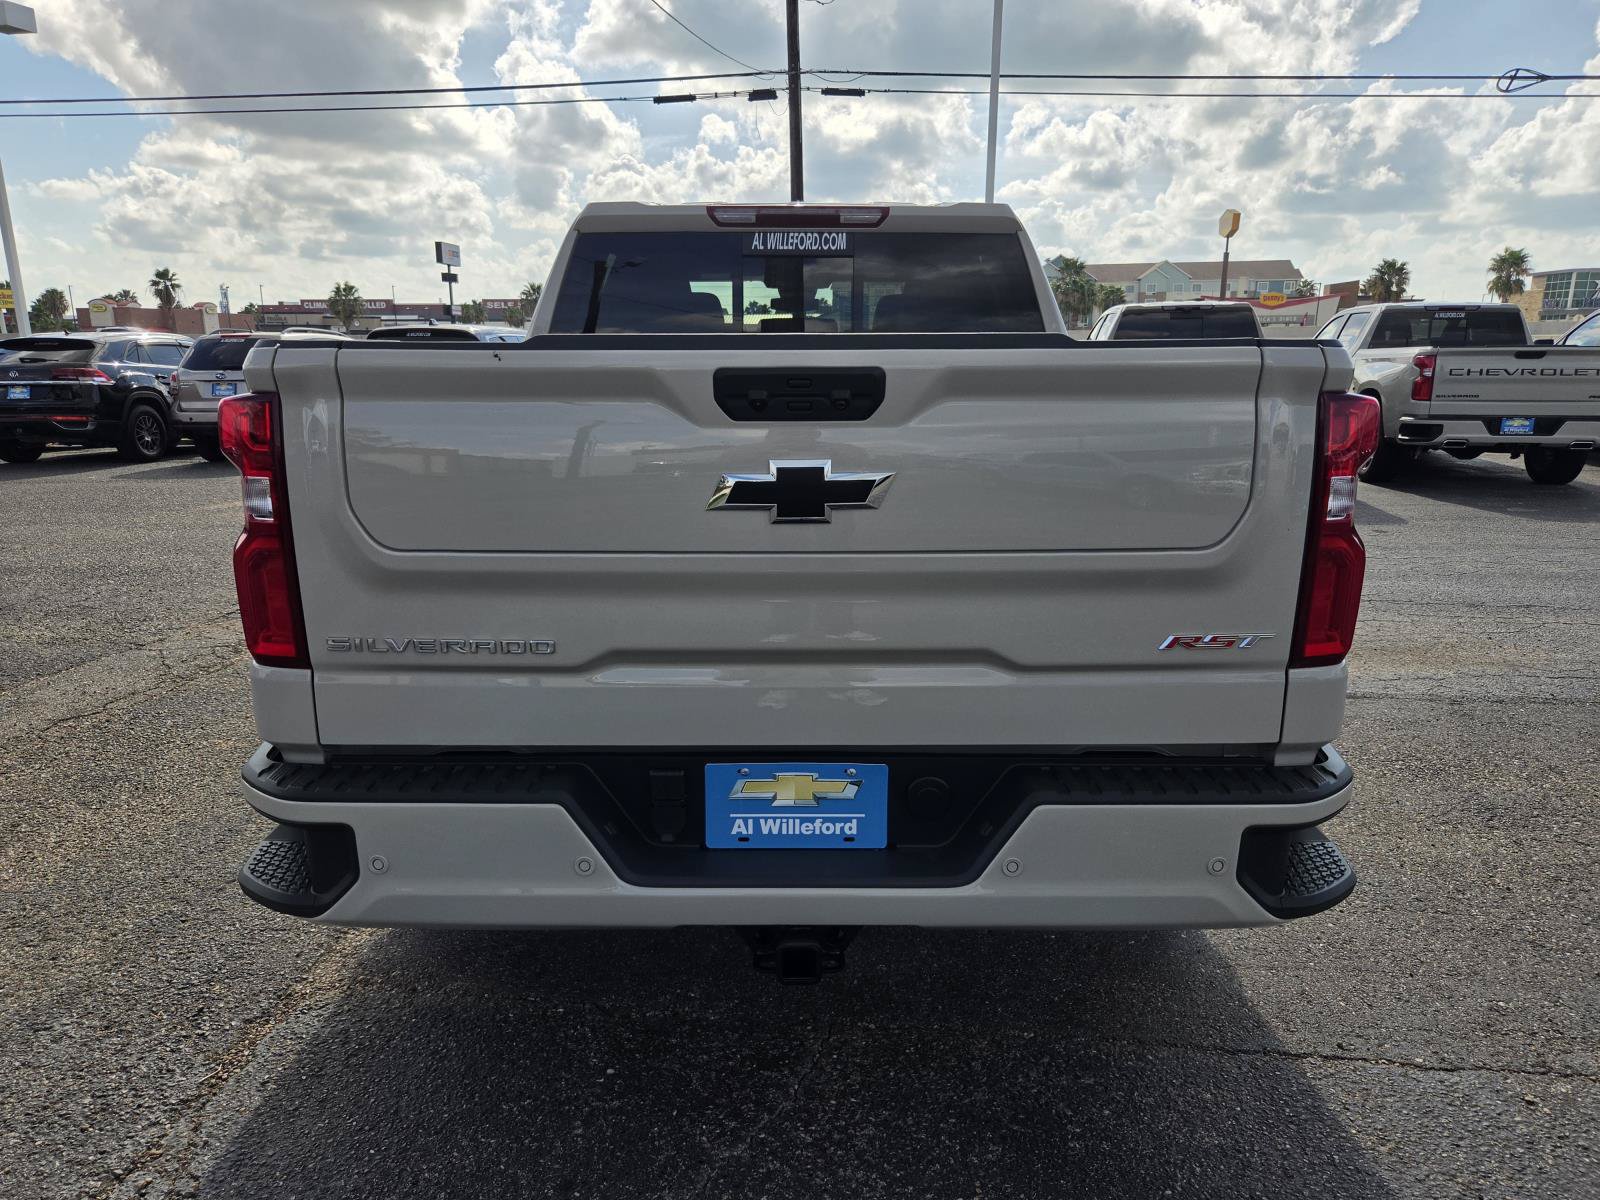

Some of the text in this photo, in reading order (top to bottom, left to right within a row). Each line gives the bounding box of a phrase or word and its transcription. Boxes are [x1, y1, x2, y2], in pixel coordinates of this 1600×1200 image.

[752, 233, 847, 250] AL WILLEFORD.COM
[1449, 368, 1600, 377] CHEVROLET
[325, 636, 556, 655] SILVERADO
[1158, 633, 1277, 650] RST
[730, 818, 858, 835] Al Willeford
